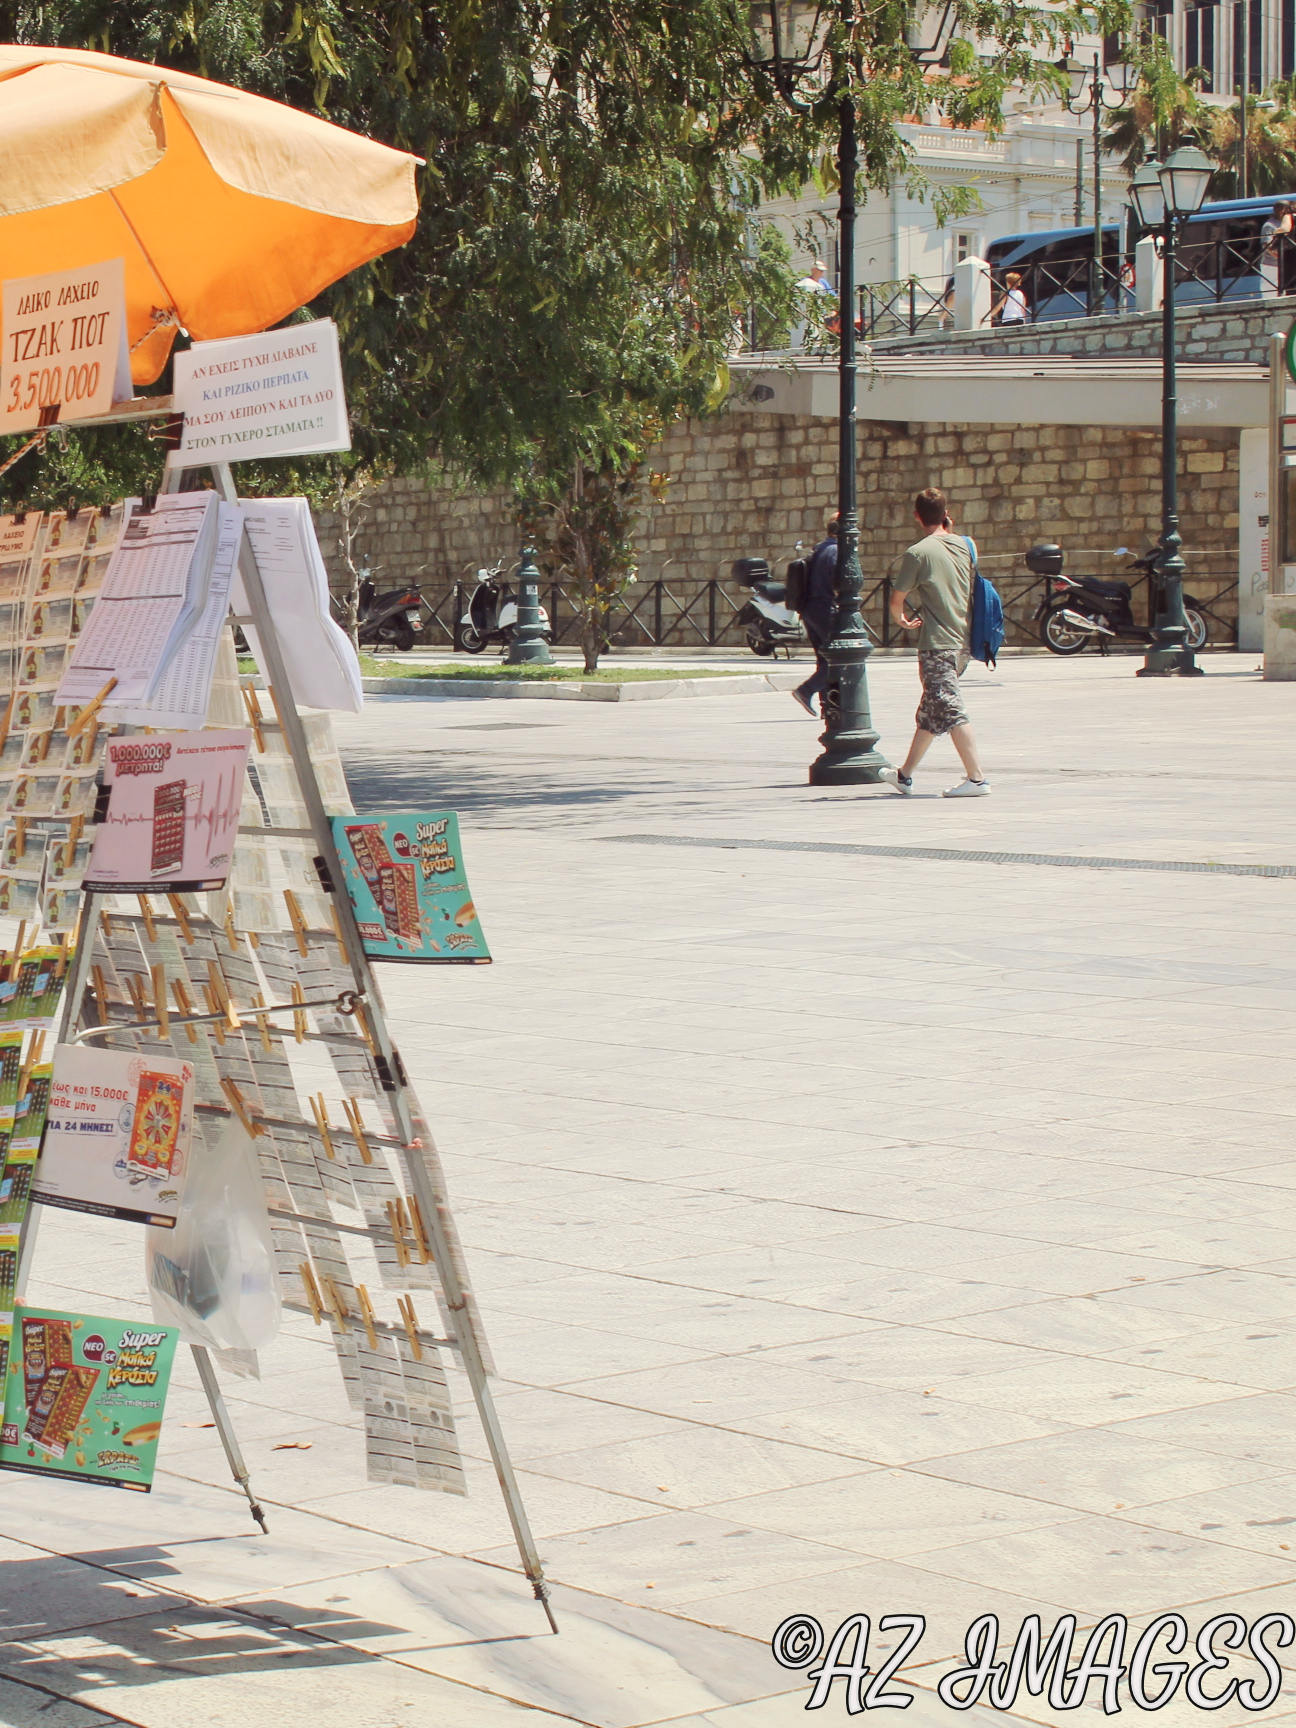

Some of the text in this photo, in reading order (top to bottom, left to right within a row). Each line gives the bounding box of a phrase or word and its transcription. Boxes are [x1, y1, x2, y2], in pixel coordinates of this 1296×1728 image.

[17, 280, 99, 316] ΛΑΙΚΟ ΛΑΧΕΙΟ
[9, 311, 110, 363] ΤΖΑΚ ΠΟΤ
[191, 341, 318, 380] ΑΝ ΕΧΕΙΣ ΤΥΧΗ ΔΙΑΒΑΙΝΕ
[203, 370, 309, 401] ΚΑΙ ΡΙΖΙΚΟ ΠΕΡΠΑΤΑ
[184, 414, 202, 428] ΜΑ
[204, 409, 226, 425] ΣΟΥ
[227, 402, 277, 422] ΛΕΙΠΟΥΝ
[278, 397, 299, 413] ΚΑΙ
[313, 389, 334, 406] ΔΥΟ
[187, 435, 218, 450] ΣΤΟΝ
[220, 428, 263, 446] ΤΥΧΕΡΟ
[265, 420, 314, 440] ΣΤΑΜΑΤΑ
[110, 742, 171, 762] 1.000.000€
[416, 817, 449, 841] Super
[394, 839, 409, 849] ΝΕΟ
[73, 1086, 87, 1095] και
[90, 1085, 129, 1101] 15.000€
[65, 1121, 77, 1131] 24
[83, 1342, 104, 1352] ΝΕΟ
[118, 1329, 167, 1351] Super
